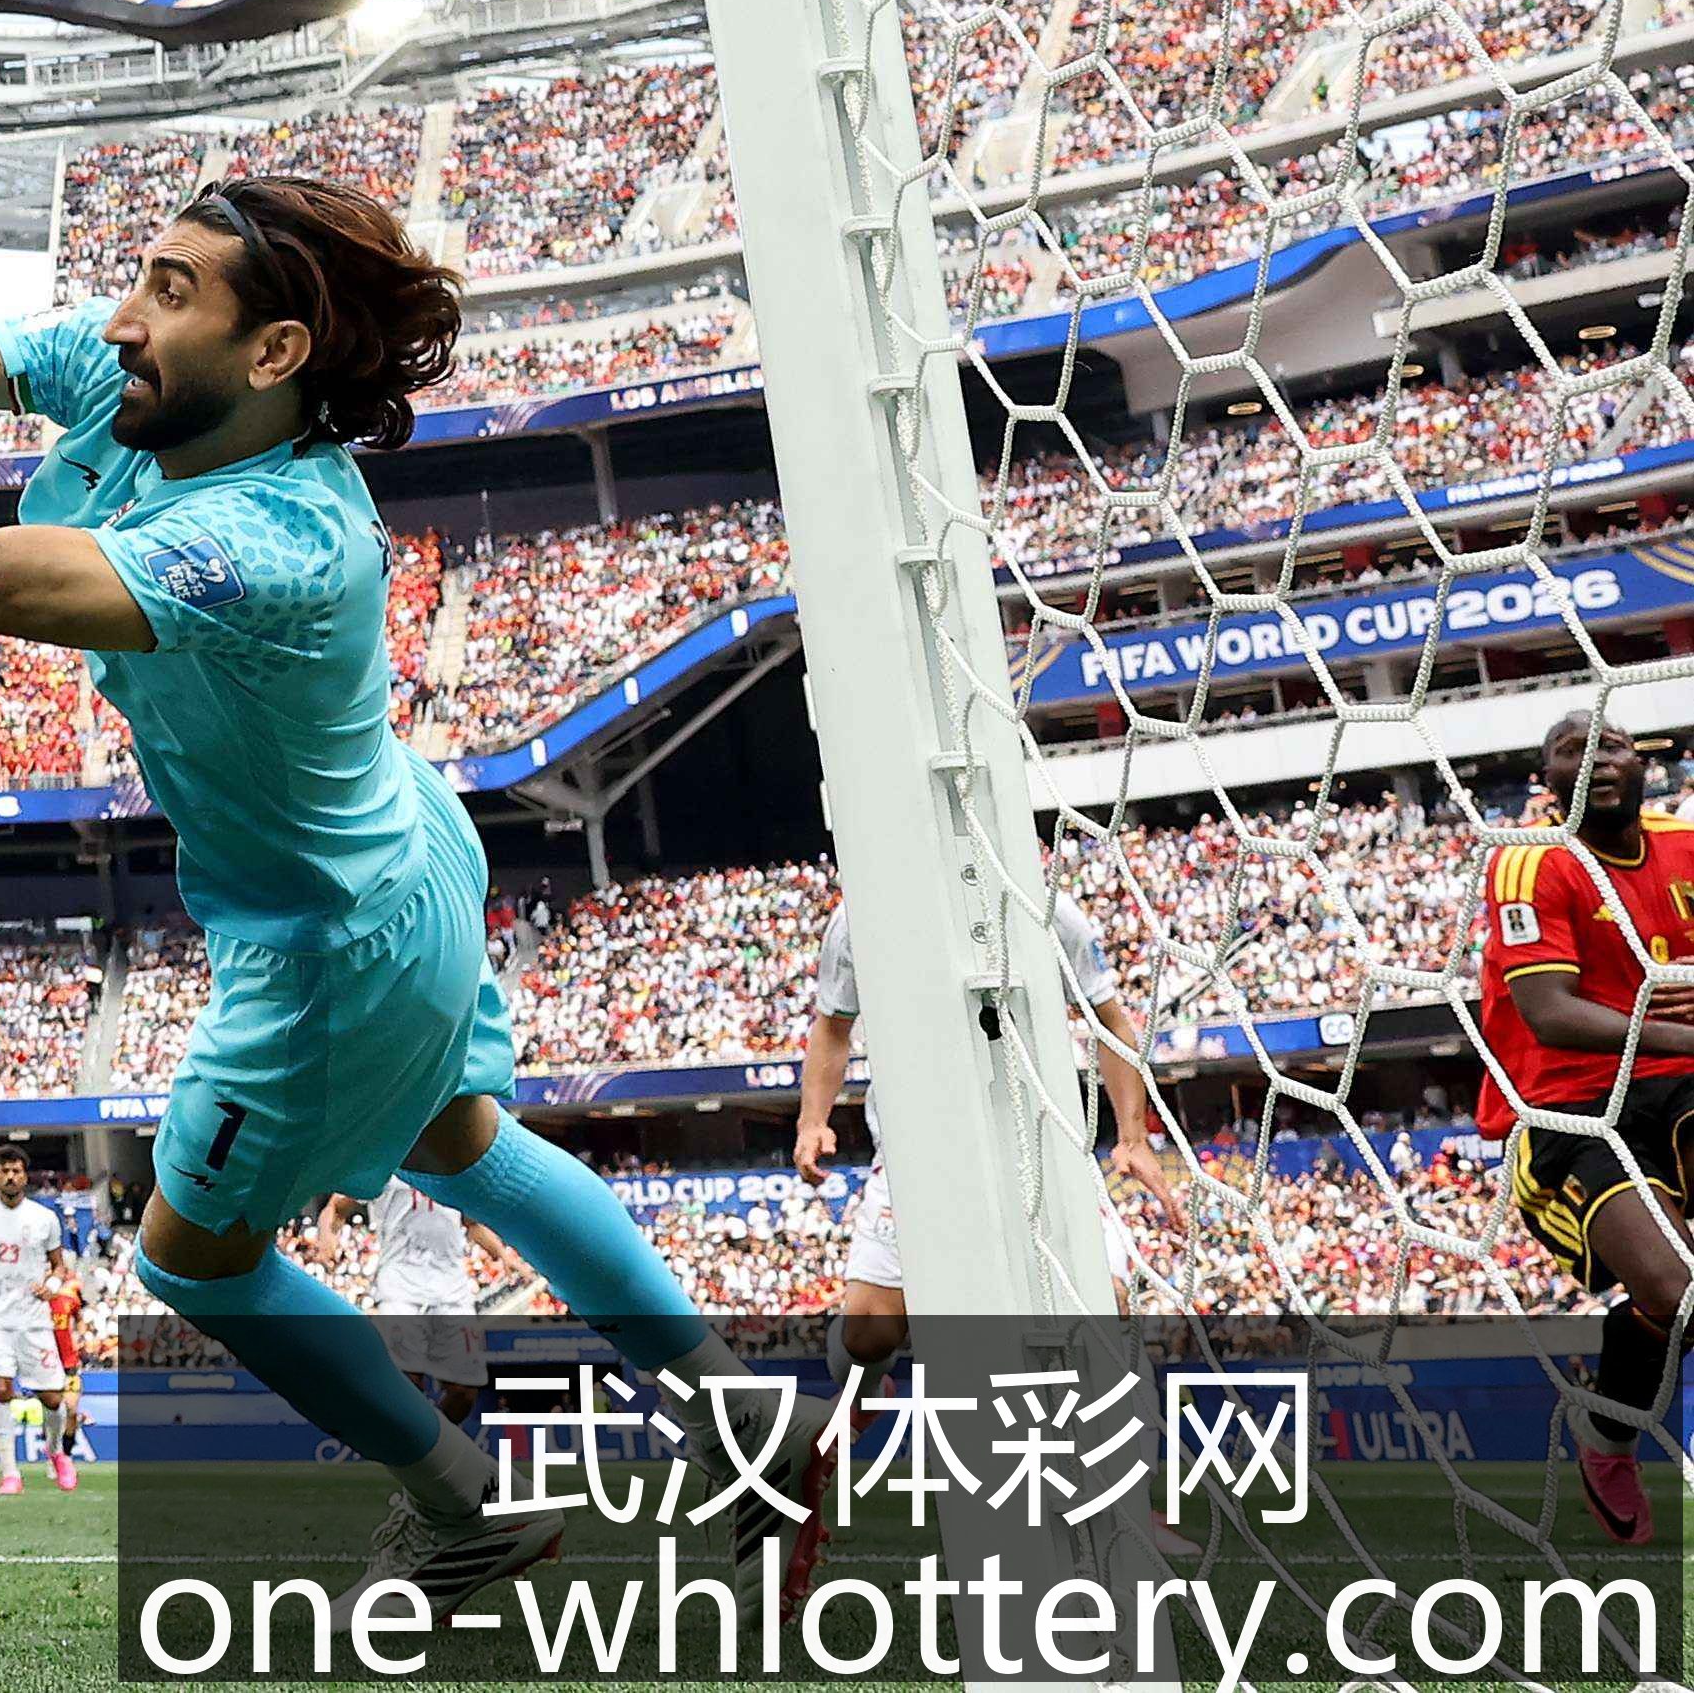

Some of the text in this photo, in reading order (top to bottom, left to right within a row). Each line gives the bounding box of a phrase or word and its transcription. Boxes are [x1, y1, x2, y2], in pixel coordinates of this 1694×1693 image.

[610, 387, 656, 411] LOS
[1175, 614, 1340, 672] WORLD
[1346, 605, 1438, 642] CUP
[1447, 569, 1623, 630] 2026
[745, 1065, 795, 1088] LOS
[205, 1102, 246, 1170] 1
[674, 1178, 735, 1203] CUP
